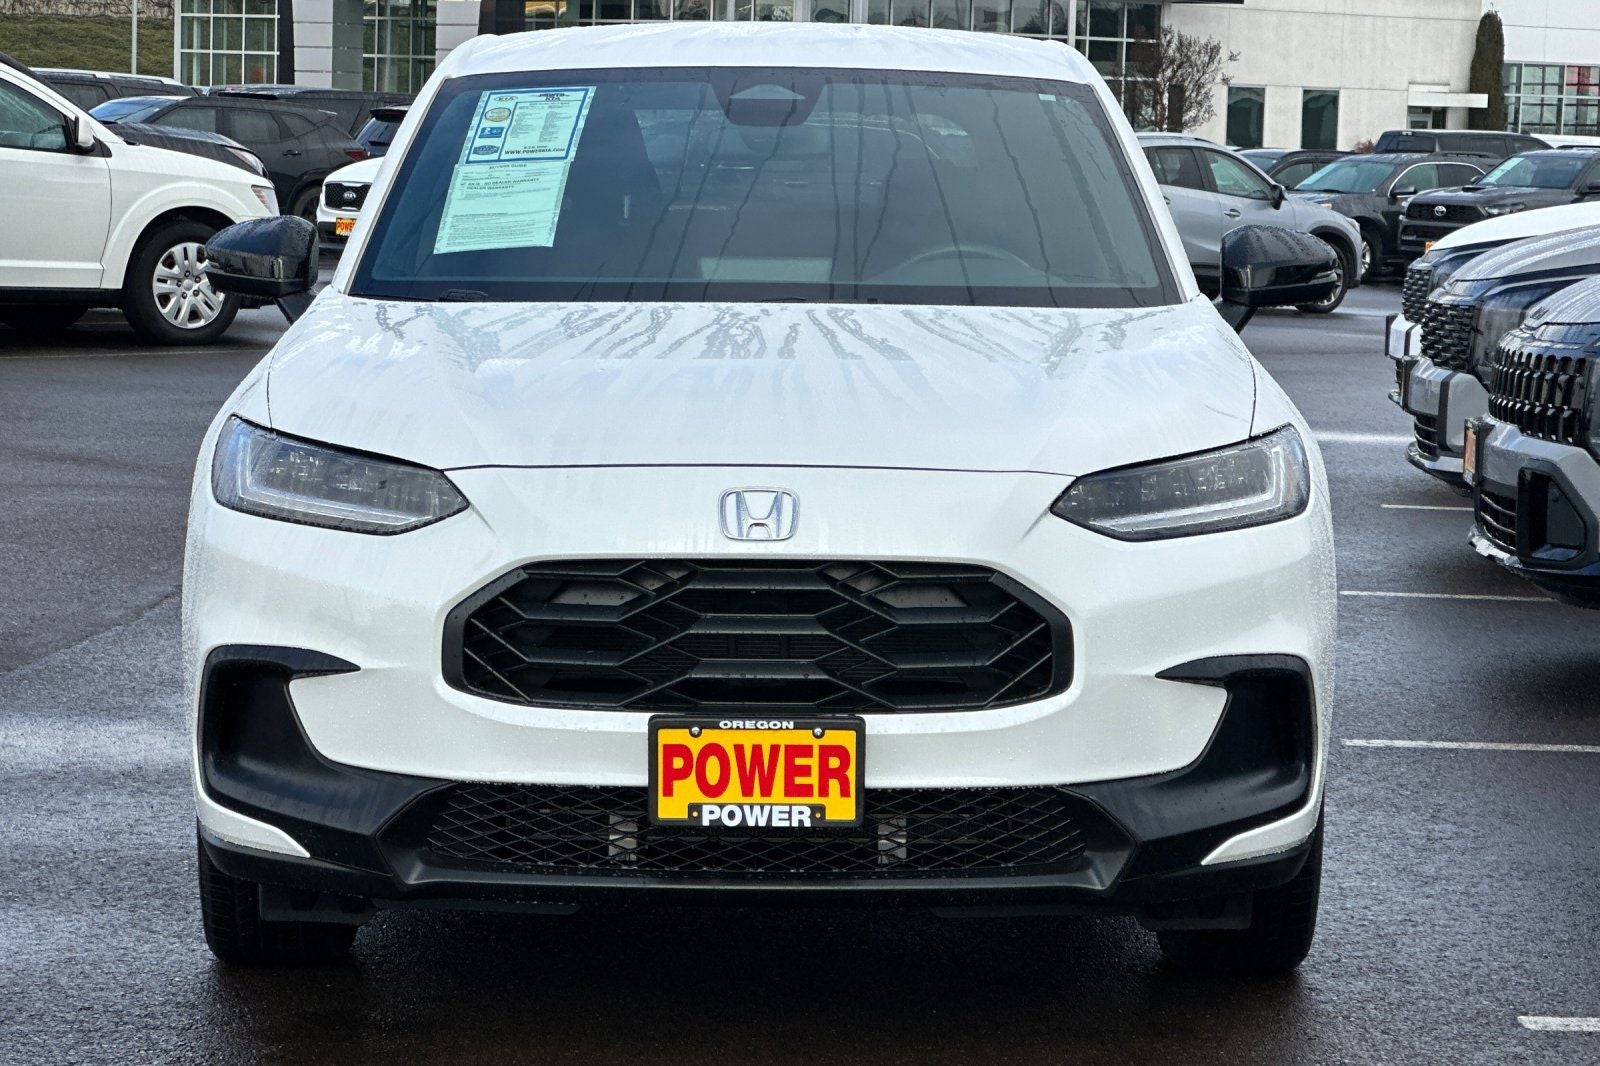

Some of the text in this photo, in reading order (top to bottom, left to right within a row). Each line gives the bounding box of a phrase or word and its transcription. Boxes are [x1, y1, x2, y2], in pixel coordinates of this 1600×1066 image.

[719, 720, 795, 730] OREGON
[662, 742, 852, 799] POWER
[701, 804, 812, 828] POWER
